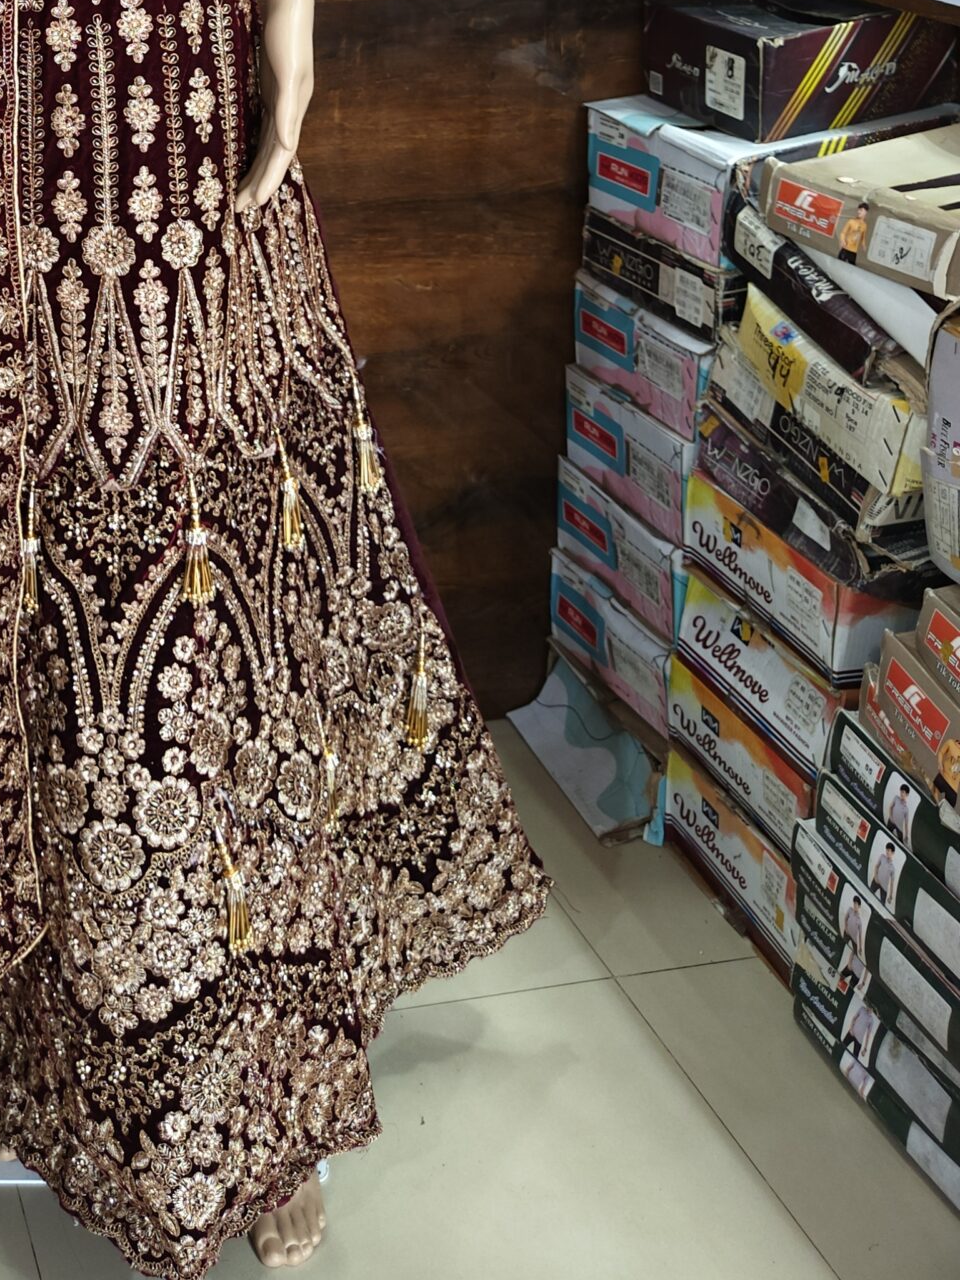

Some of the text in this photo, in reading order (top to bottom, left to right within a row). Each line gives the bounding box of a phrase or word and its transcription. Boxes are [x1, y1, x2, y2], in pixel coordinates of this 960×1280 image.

[775, 202, 830, 229] FREELINE
[692, 520, 773, 604] Wellmove
[692, 615, 770, 703] Wellmove
[885, 679, 933, 741] FREELINE
[673, 703, 751, 796] Wellmove
[673, 792, 748, 890] Wellmove
[815, 917, 837, 942] COLLAR
[818, 983, 839, 1009] COLLAR
